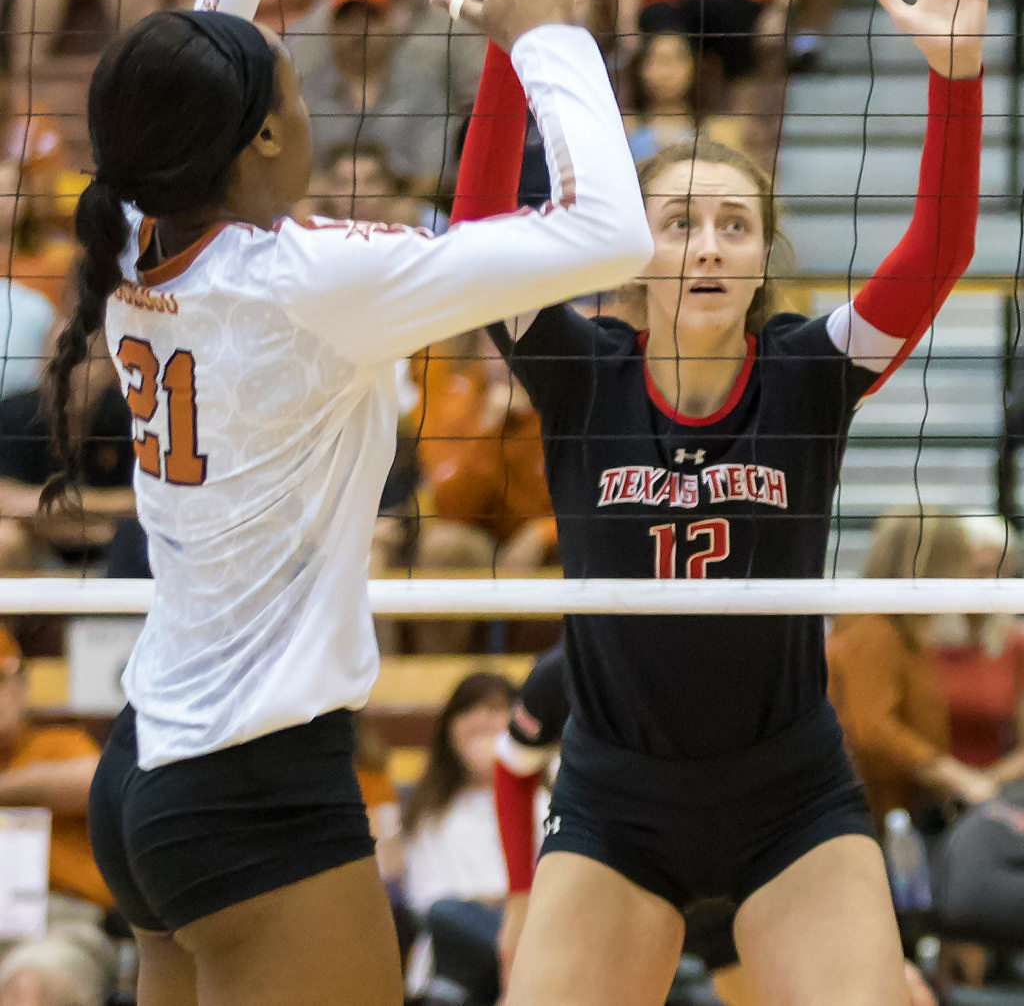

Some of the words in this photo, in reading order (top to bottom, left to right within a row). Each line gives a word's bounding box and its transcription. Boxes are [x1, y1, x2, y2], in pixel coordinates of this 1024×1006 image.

[116, 334, 208, 486] 21
[597, 465, 699, 509] TEXAS
[701, 463, 788, 509] TECH
[649, 517, 730, 579] 12
